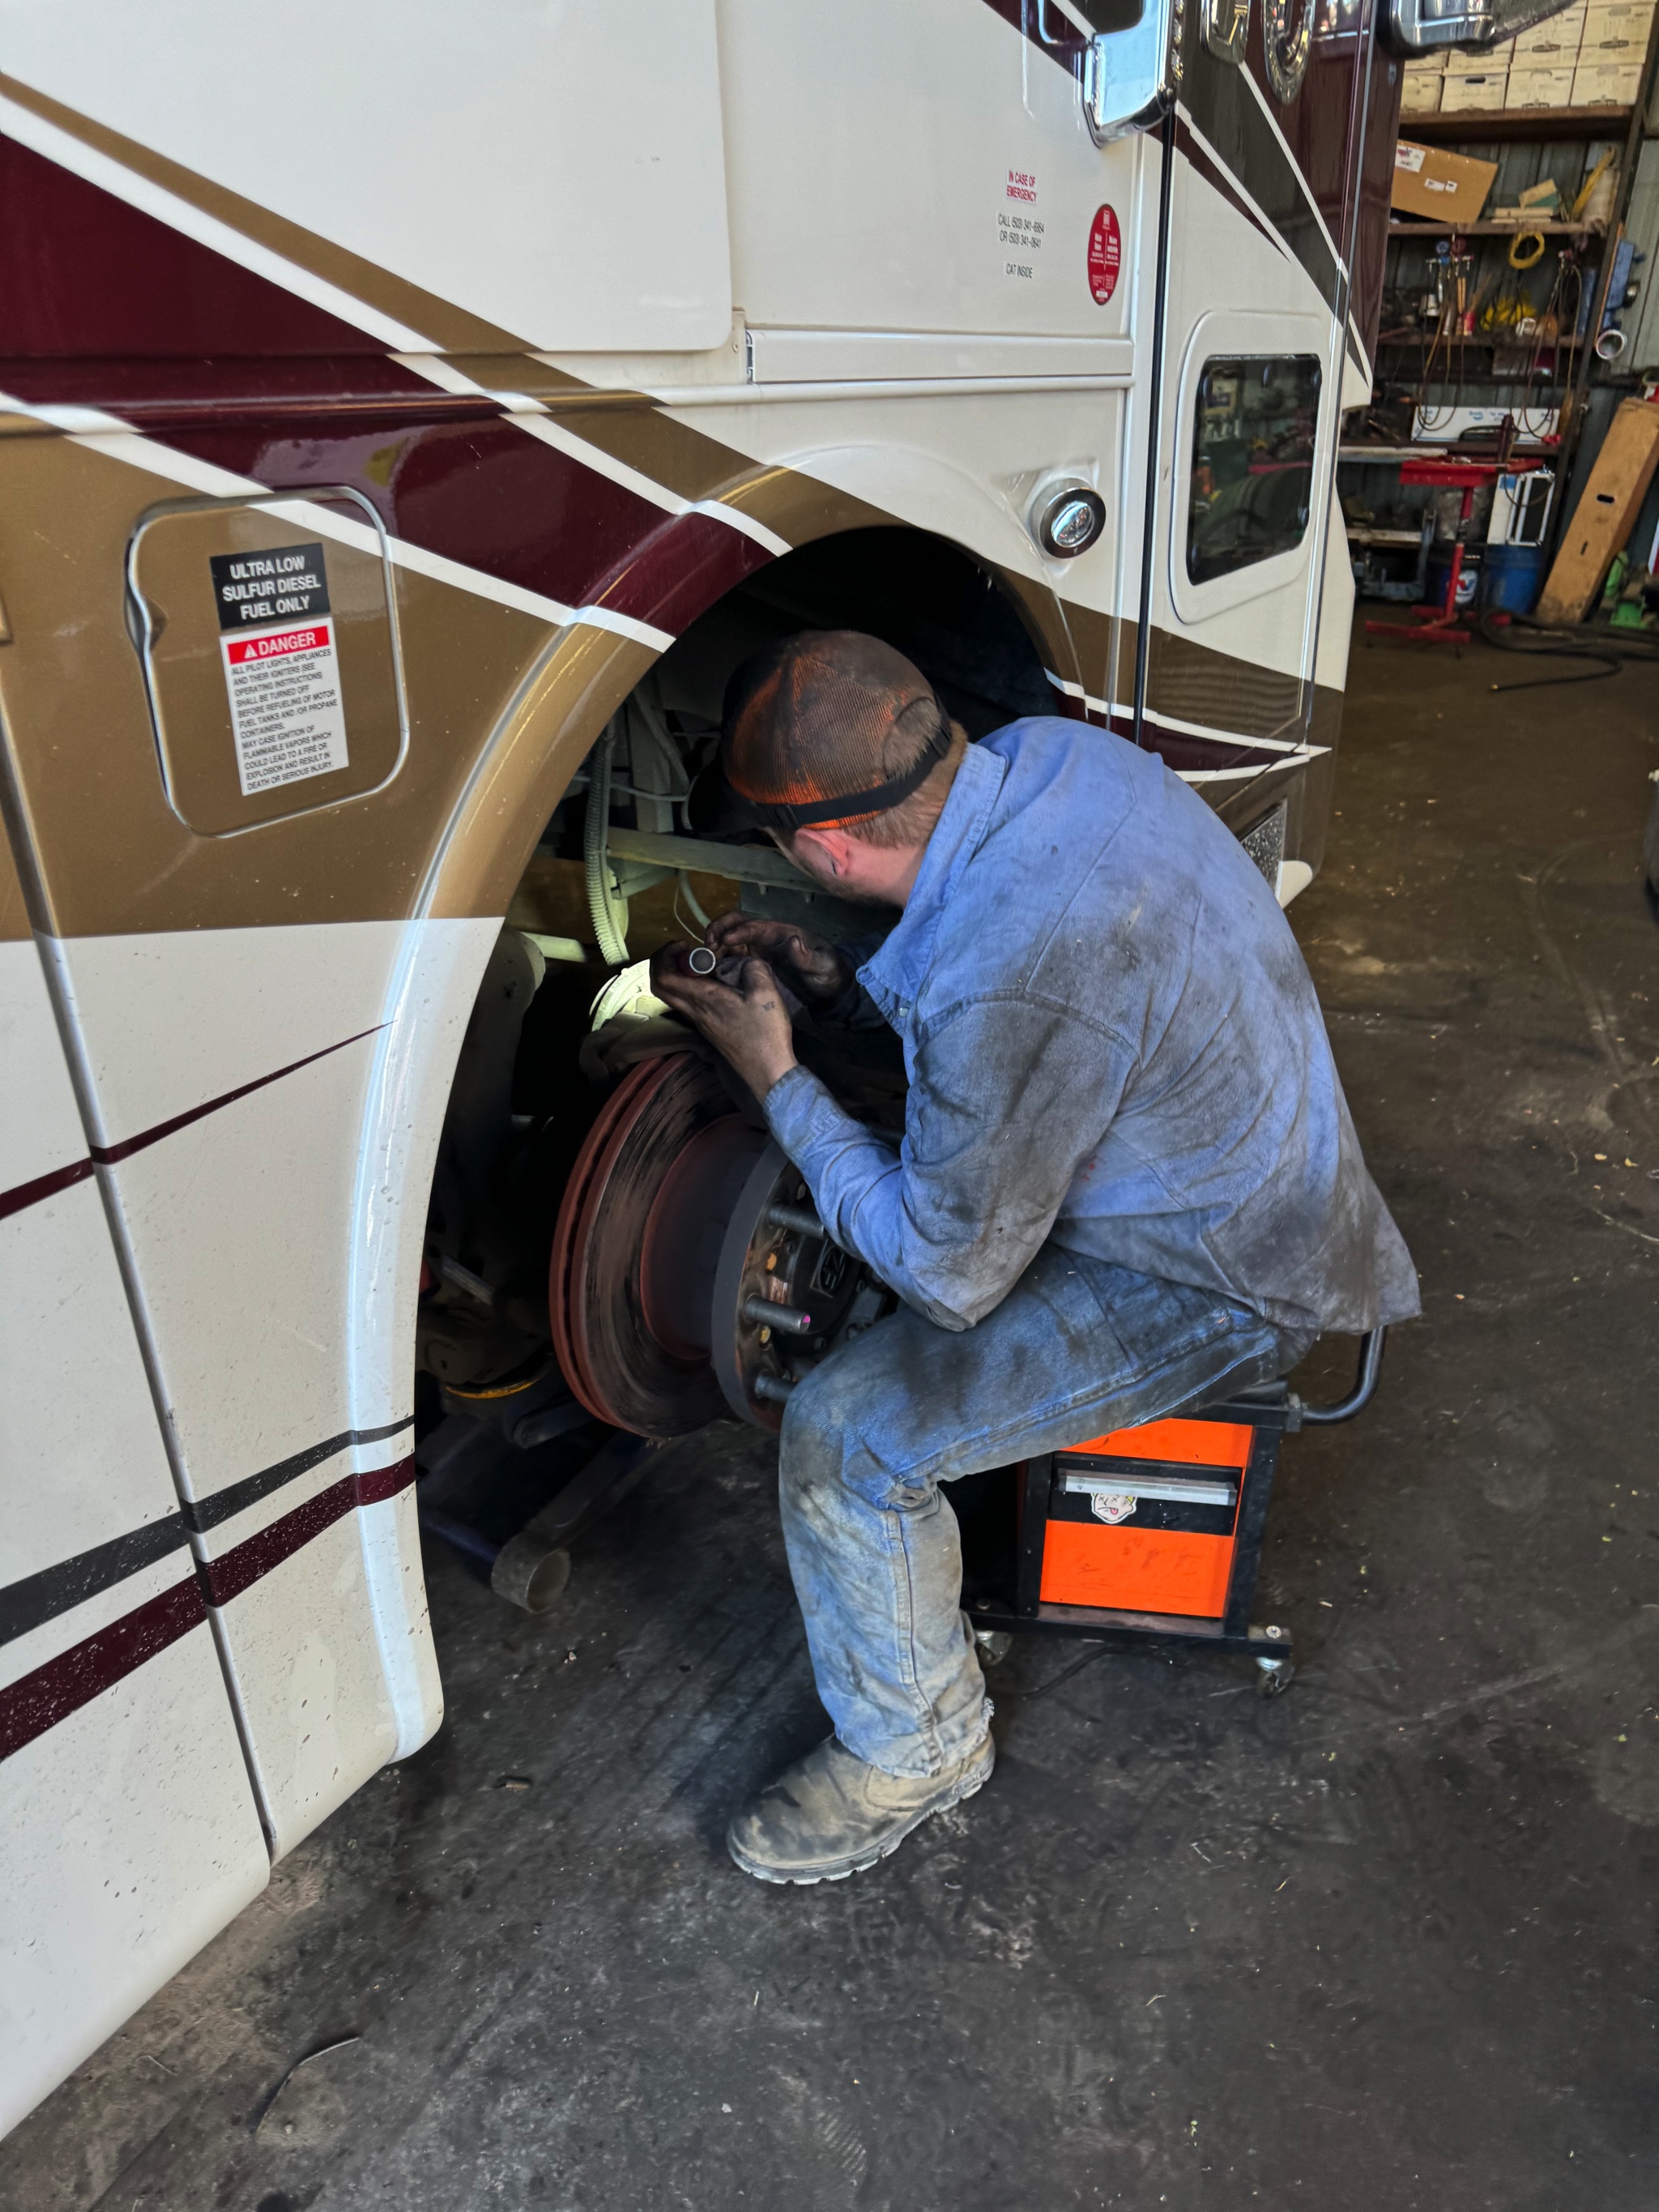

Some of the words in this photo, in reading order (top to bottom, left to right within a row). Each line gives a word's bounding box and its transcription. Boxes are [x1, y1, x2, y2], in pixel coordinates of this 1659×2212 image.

[1009, 170, 1013, 181] IN
[1014, 172, 1028, 186] CASE
[1028, 176, 1035, 187] OF
[1006, 185, 1036, 202] EMERGENCY
[998, 213, 1010, 227] CALL
[1000, 229, 1008, 241] OR
[1005, 263, 1016, 275] CAT
[1017, 265, 1033, 278] INSIDE
[230, 560, 275, 579] ULTRA
[275, 556, 305, 573] LOW
[223, 580, 275, 601] SULFUR
[277, 574, 321, 593] DIESEL
[240, 601, 275, 619] FUEL
[275, 595, 309, 613] ONLY
[258, 632, 315, 655] DANGER
[232, 667, 244, 675] ALL
[245, 661, 265, 672] PILOT
[293, 648, 331, 662] APPLIANCES
[234, 677, 247, 685] AND
[249, 672, 269, 681] THEIR
[271, 665, 300, 677] IGNITERS
[235, 682, 273, 697] OPERATING
[237, 698, 258, 707] SHALL
[259, 694, 268, 702] BE
[270, 688, 296, 698] TURNED
[296, 684, 309, 694] OFF
[238, 705, 264, 718] BEFORE
[266, 697, 301, 711] REFUELING
[303, 694, 311, 703] OF
[313, 689, 335, 700] MOTOR
[239, 719, 257, 728] FUEL
[258, 712, 279, 722] TANKS
[281, 709, 294, 718] AND
[309, 698, 337, 710] PROPANE
[242, 741, 256, 749] MAY
[258, 734, 276, 745] CASE
[277, 728, 305, 740] IGNITION
[306, 724, 314, 733] OF
[244, 743, 284, 758] FLAMMABLE
[285, 737, 310, 749] VAPORS
[311, 732, 331, 741] WHICH
[245, 758, 268, 770] COULD
[270, 753, 286, 763] LEAD
[287, 750, 296, 758] TO
[303, 745, 317, 754] FIRE
[318, 742, 327, 750] OR
[246, 764, 283, 780] EXPLOSION
[285, 760, 297, 769] AND
[299, 754, 322, 765] RESULT
[247, 778, 270, 790] DEATH
[271, 775, 280, 784] OR
[282, 767, 309, 780] SERIOUS
